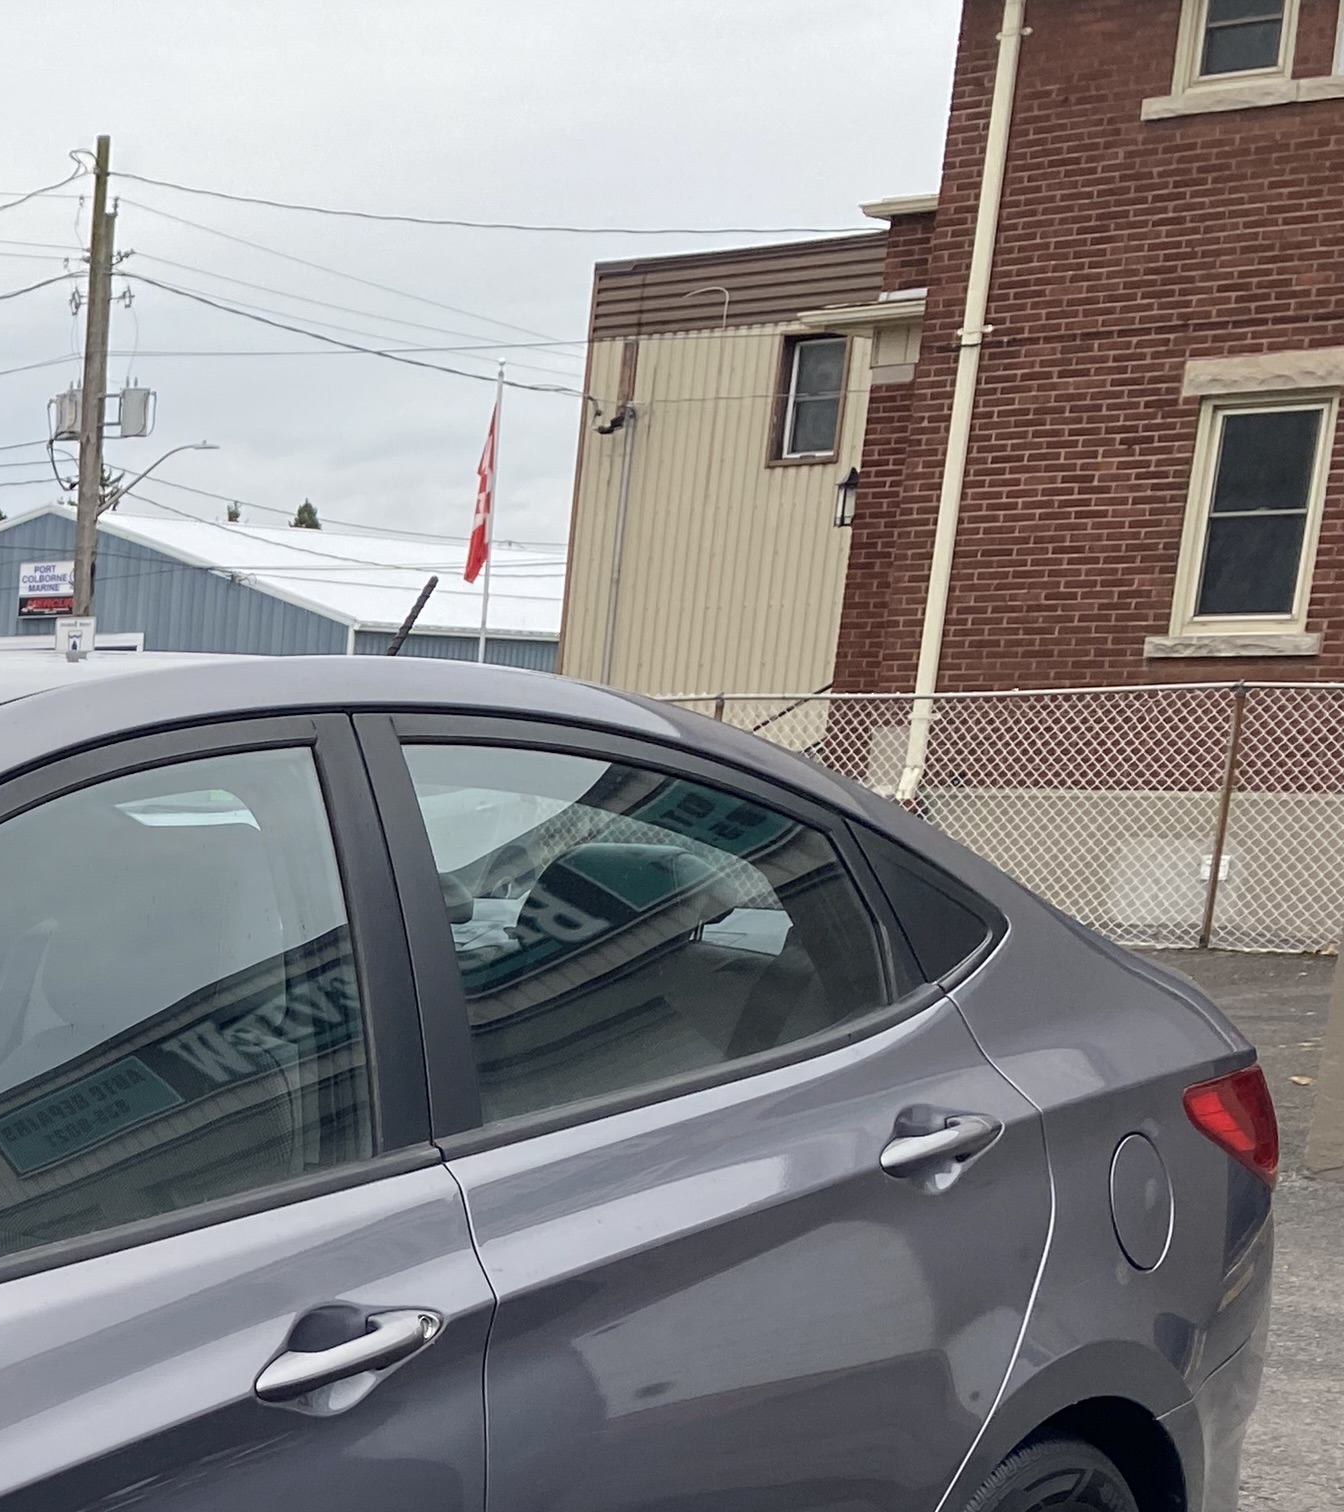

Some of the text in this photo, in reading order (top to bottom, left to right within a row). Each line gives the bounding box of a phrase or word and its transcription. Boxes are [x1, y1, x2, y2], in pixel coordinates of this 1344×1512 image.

[34, 564, 56, 574] PORT
[22, 573, 67, 584] COLBORNE
[28, 584, 59, 592] MARINE
